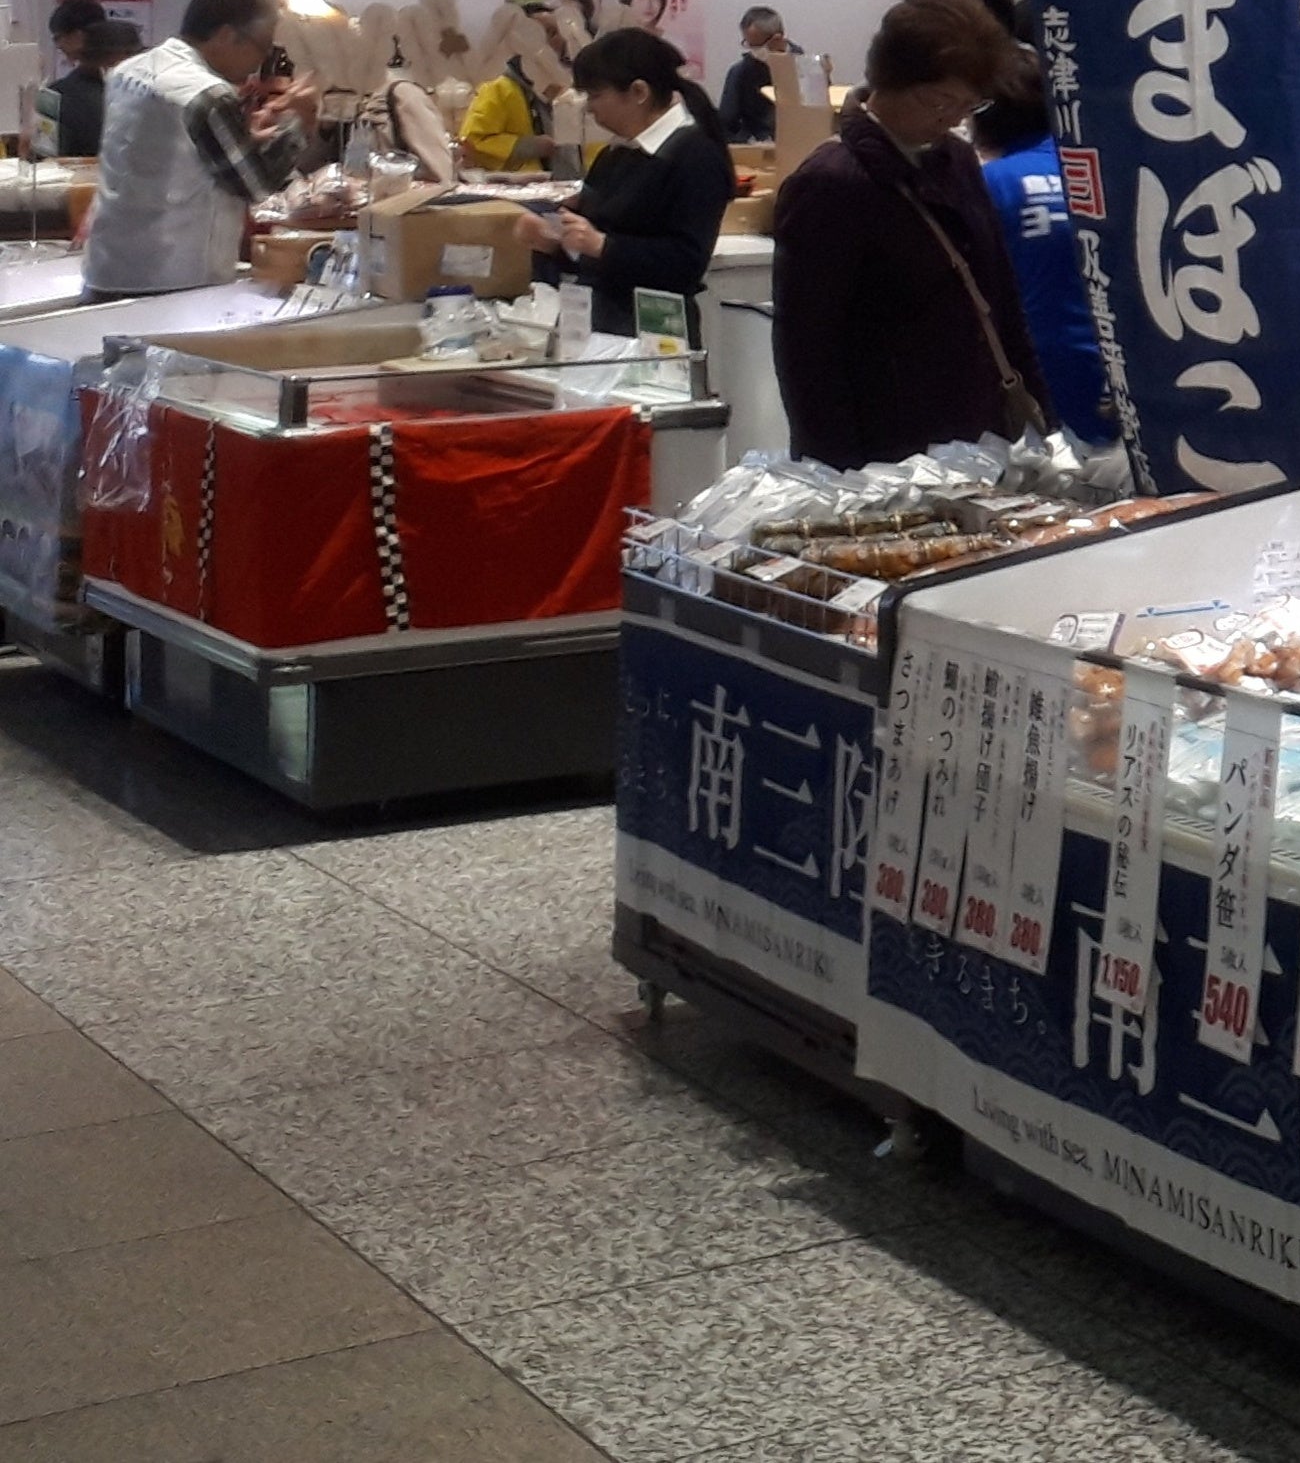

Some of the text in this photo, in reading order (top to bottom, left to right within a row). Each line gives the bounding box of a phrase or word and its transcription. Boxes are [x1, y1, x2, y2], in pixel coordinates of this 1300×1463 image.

[1042, 5, 1082, 146] 志津川
[1215, 758, 1248, 929] パンダ笹
[1205, 974, 1250, 1038] 540
[972, 1083, 1021, 1143] Living
